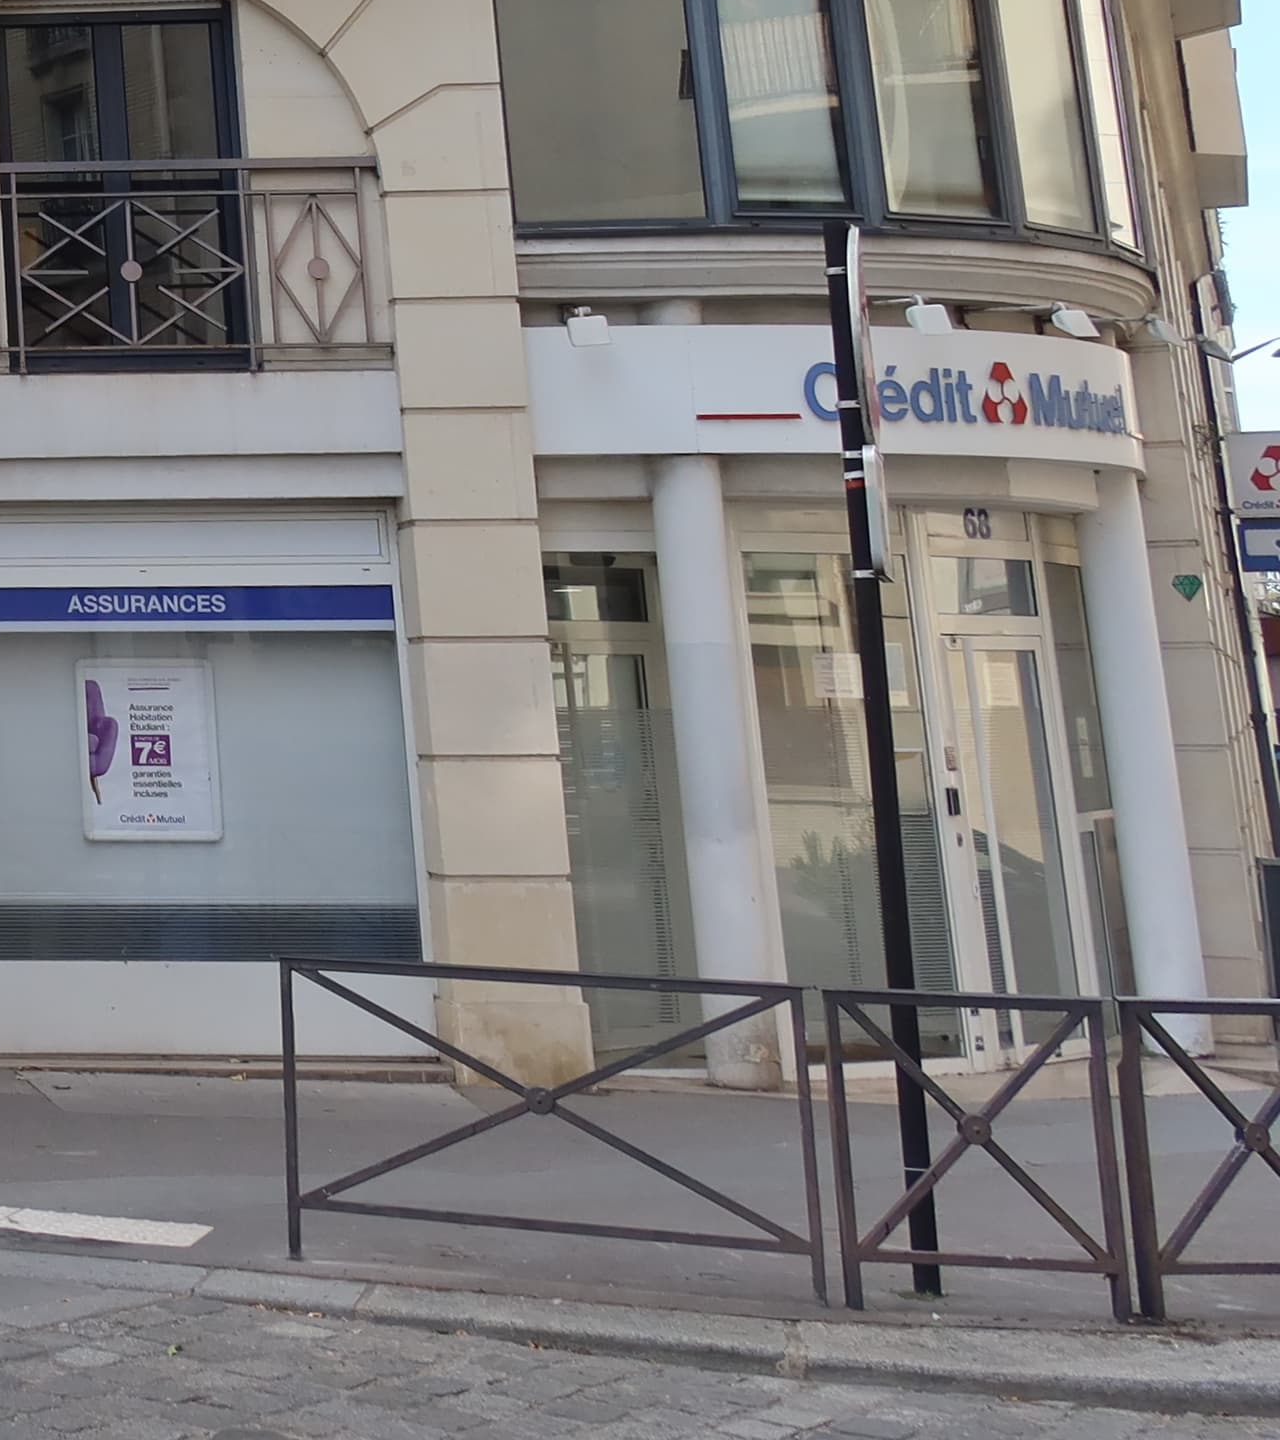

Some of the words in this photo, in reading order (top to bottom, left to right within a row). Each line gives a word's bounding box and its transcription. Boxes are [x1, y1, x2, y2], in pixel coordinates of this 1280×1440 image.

[804, 361, 977, 423] Cédit
[963, 509, 992, 539] 68
[67, 594, 226, 614] ASSURANCES
[129, 703, 174, 711] Assurance
[129, 713, 173, 721] Habitation
[132, 771, 172, 779] garanties
[133, 780, 182, 788] essentielles
[120, 814, 146, 823] Crédit
[156, 815, 185, 823] Mutuel
